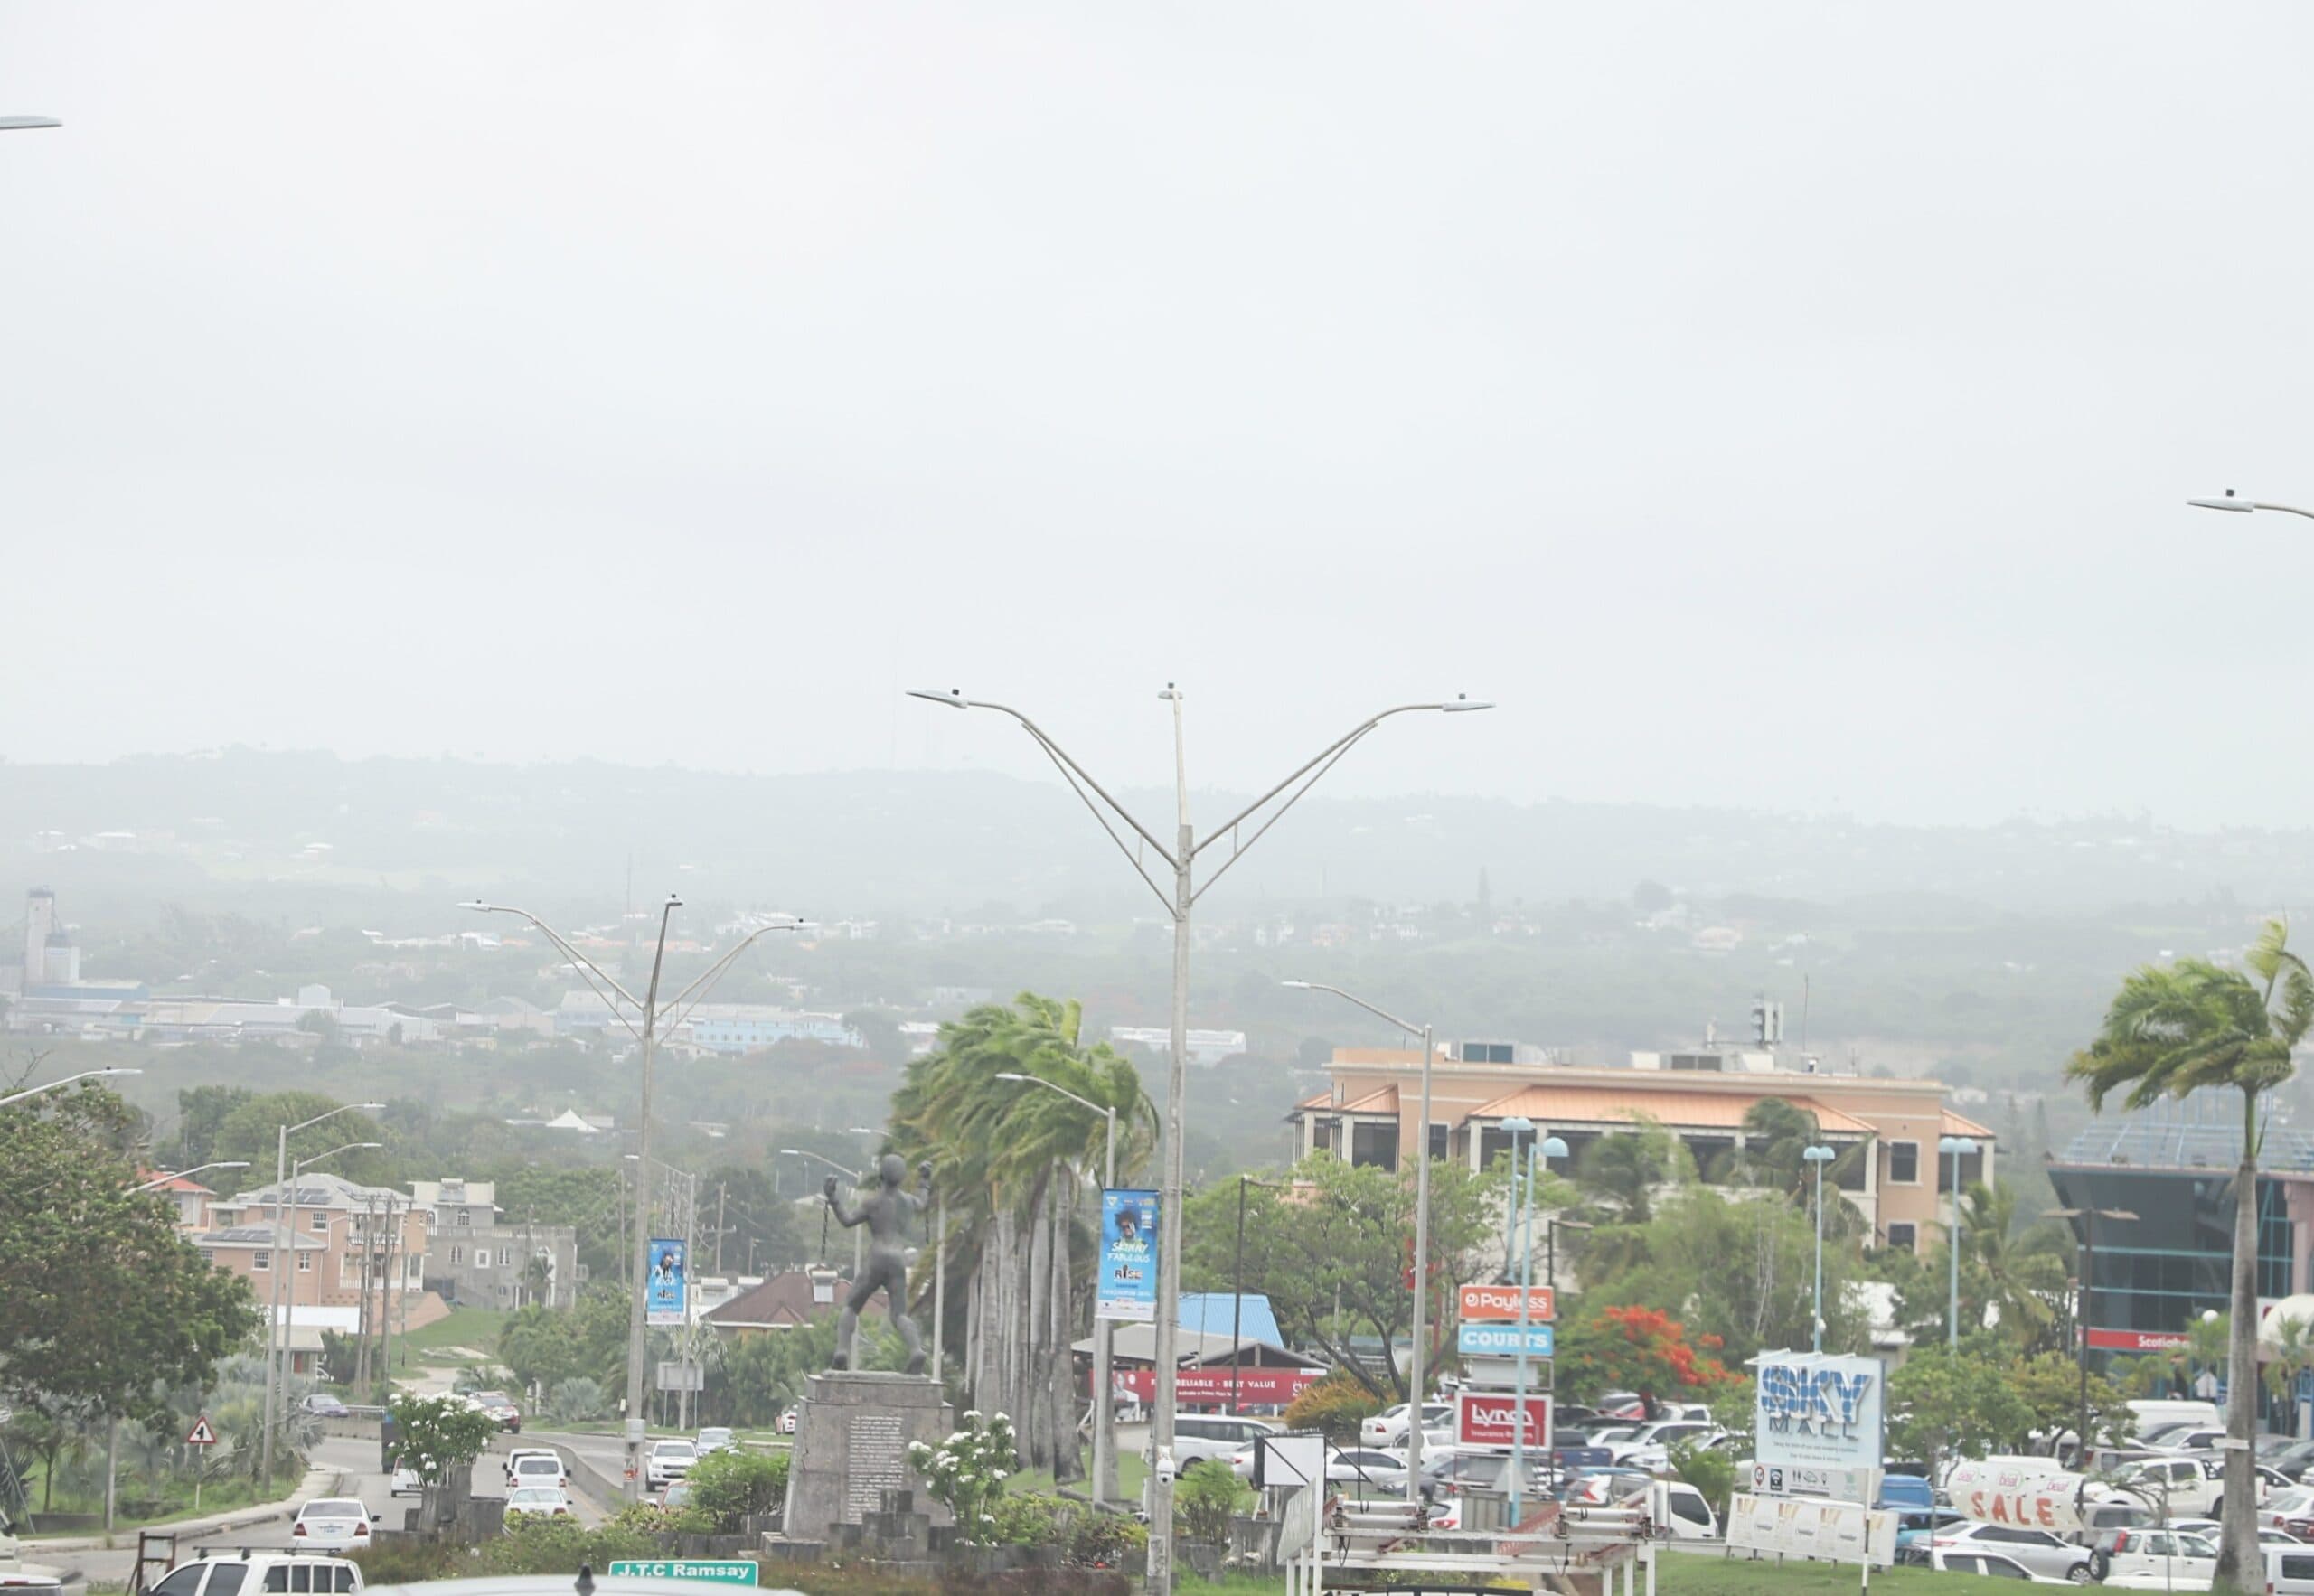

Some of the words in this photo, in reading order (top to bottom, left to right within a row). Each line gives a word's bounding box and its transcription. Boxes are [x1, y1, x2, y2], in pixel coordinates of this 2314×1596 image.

[1114, 1264, 1143, 1280] RISE
[1480, 1293, 1547, 1312] Paylss
[1176, 1378, 1214, 1387] RELIABLE
[1248, 1380, 1275, 1389] VALUE
[1761, 1365, 1874, 1425] SKY
[1769, 1416, 1858, 1441] MALL
[1971, 1491, 2055, 1526] SALE
[673, 1563, 749, 1579] Ramsay
